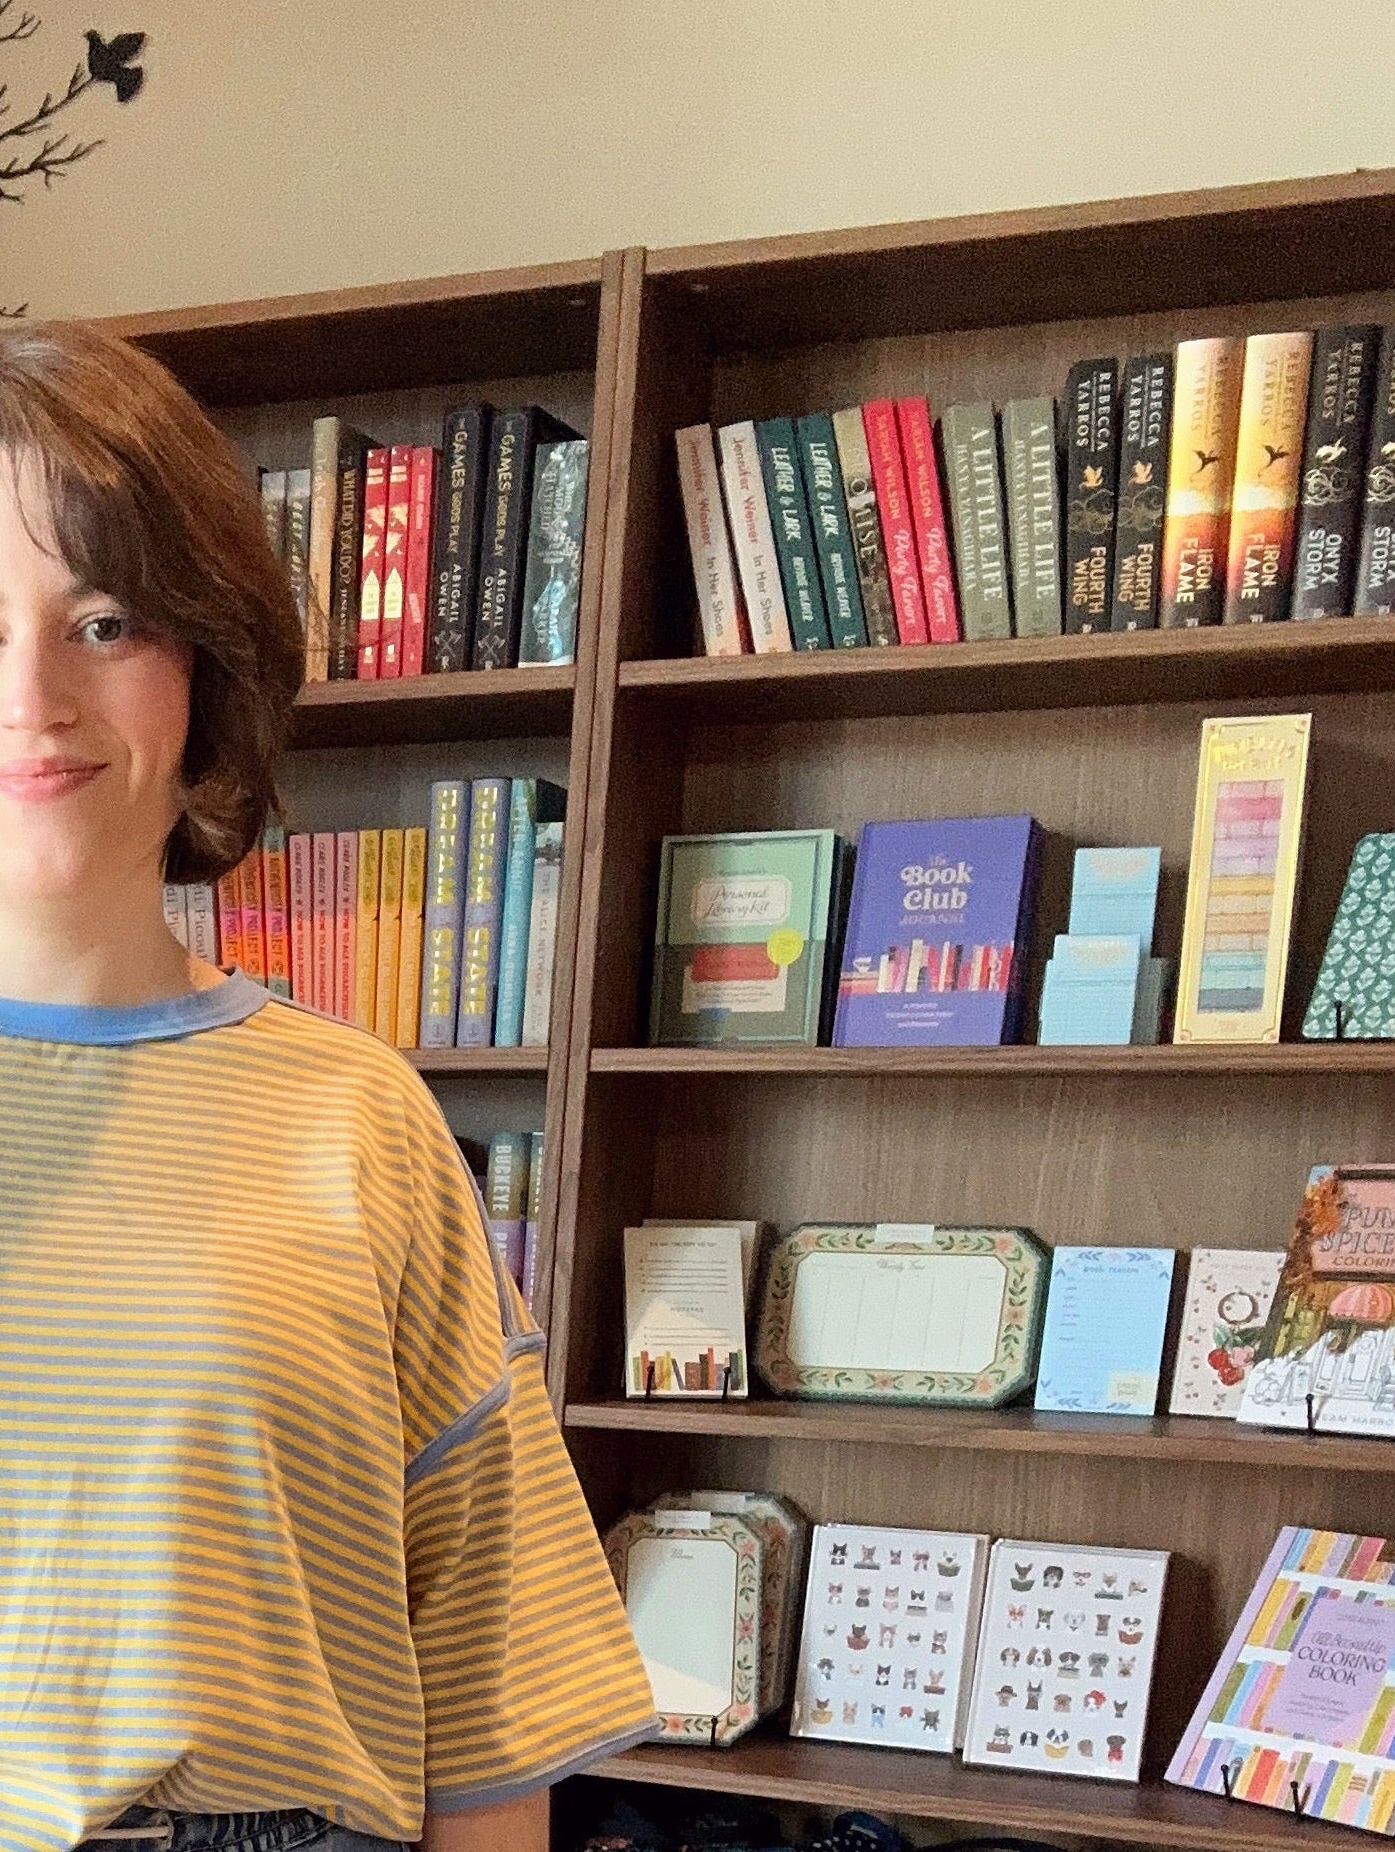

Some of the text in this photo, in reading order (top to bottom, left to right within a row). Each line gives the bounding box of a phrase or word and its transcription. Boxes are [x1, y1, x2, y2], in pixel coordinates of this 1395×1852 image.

[1076, 380, 1091, 447] YARROS
[1097, 372, 1112, 452] REBECCA
[1127, 375, 1144, 443] YARROS
[1147, 366, 1165, 447] REBECCA
[1322, 349, 1341, 419] YARROS
[1343, 341, 1364, 424] REBECCA
[451, 431, 468, 489] GAMES
[496, 434, 516, 492] GAMES
[782, 509, 801, 541] LARK
[820, 505, 840, 538] LARK
[970, 426, 1002, 601] A LITTLE LIFE
[1029, 422, 1056, 600] A LITTLE LIFE
[1072, 558, 1090, 605] WING
[1088, 546, 1106, 613] FOURTH
[1118, 555, 1134, 602] WING
[1134, 543, 1154, 611] FOURTH
[1175, 538, 1199, 604] FLAME
[1197, 548, 1214, 590] IRON
[1241, 534, 1264, 599] FLAME
[1262, 544, 1280, 587] IRON
[1303, 528, 1326, 591] STORM
[1324, 534, 1343, 584] ONYX
[1368, 526, 1391, 589] STORM
[437, 571, 449, 617] OWEN
[448, 564, 462, 624] ABIGAIL
[481, 576, 495, 622] OWEN
[492, 567, 508, 629] ABIGAIL
[429, 789, 459, 1016] DREAM STATE
[464, 787, 499, 1015] DREAM STATE
[900, 862, 973, 886] Book
[903, 888, 968, 911] Club
[493, 1145, 512, 1212] BUCKEYE
[1297, 1646, 1386, 1673] COLORING
[1308, 1665, 1360, 1686] BOOK
